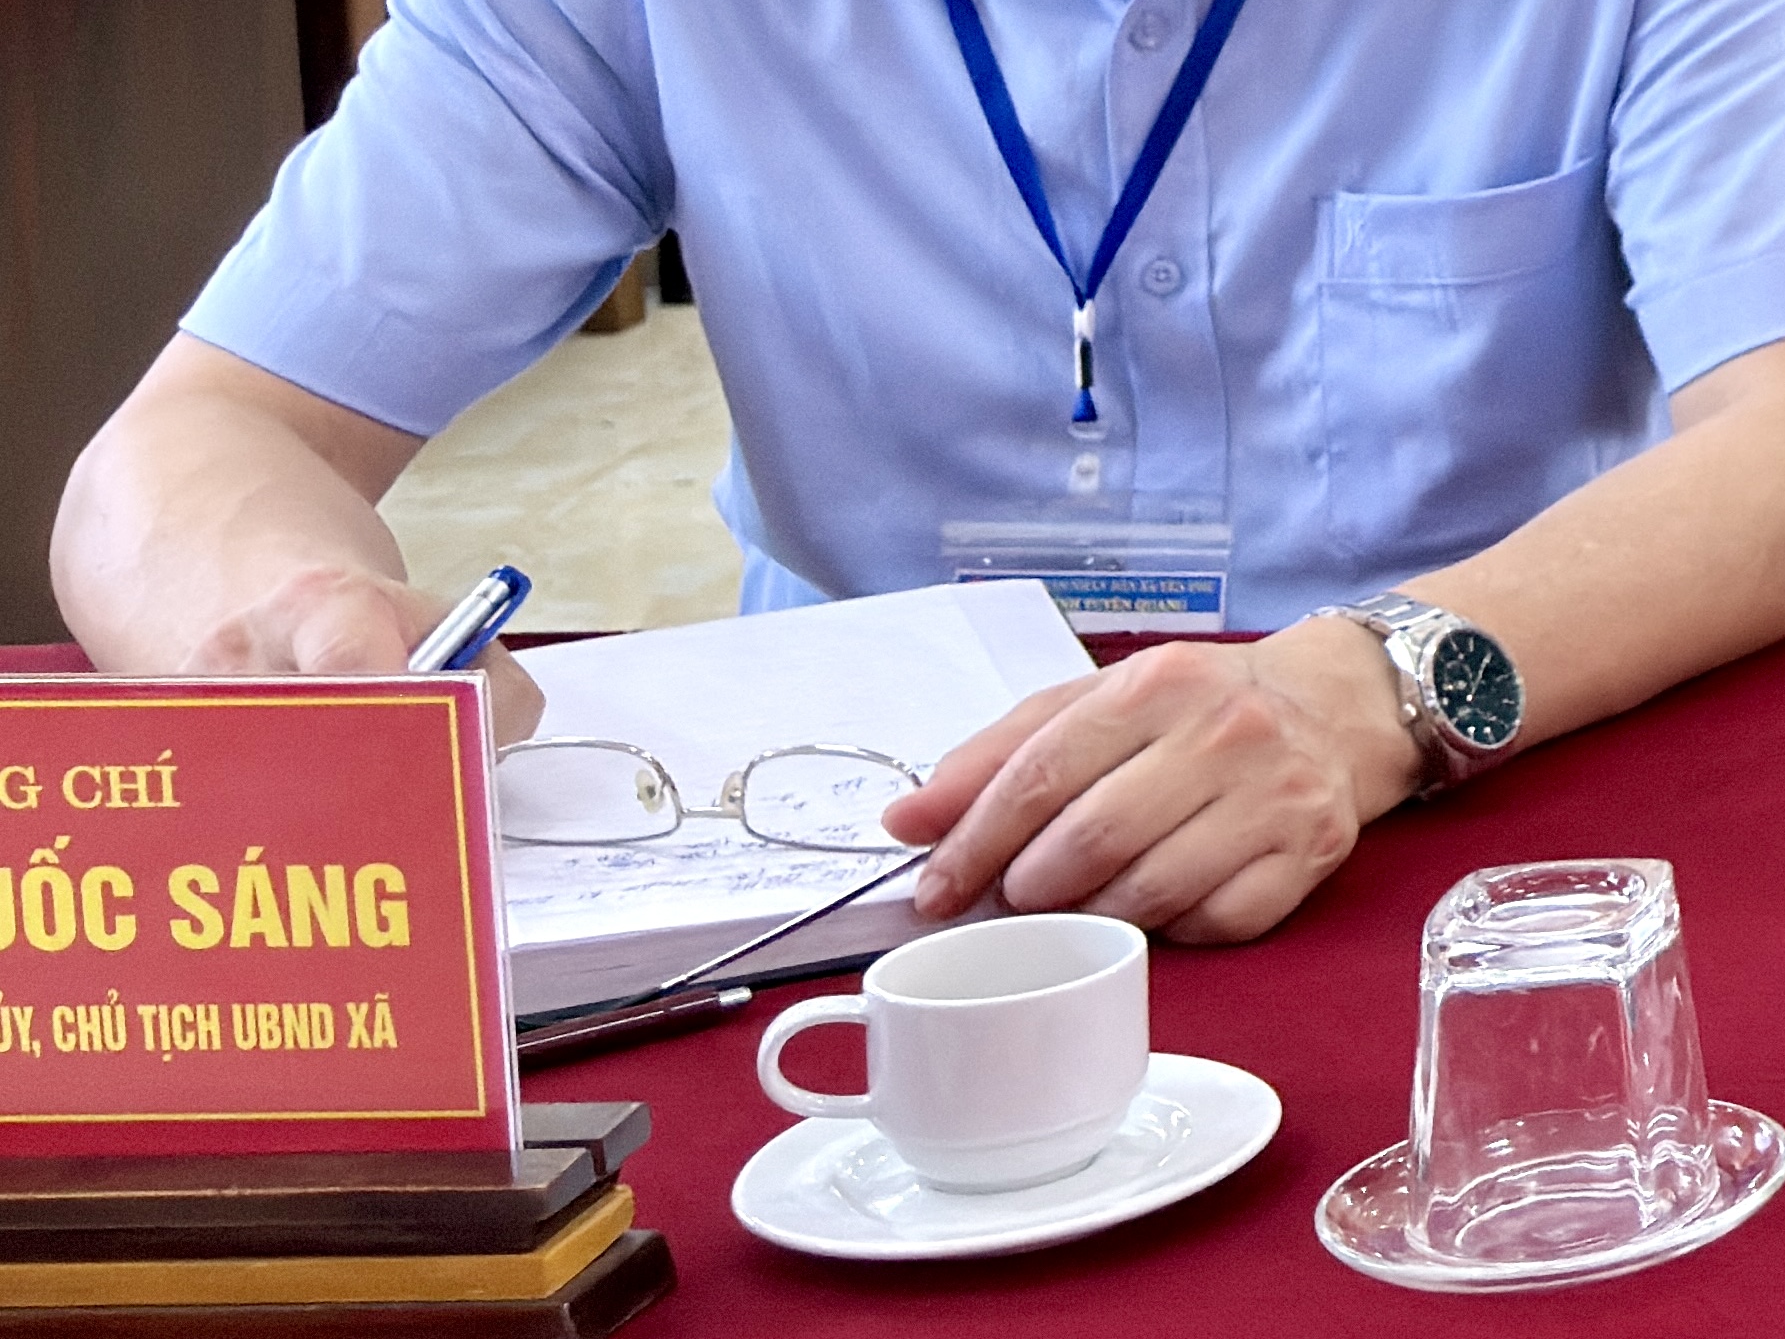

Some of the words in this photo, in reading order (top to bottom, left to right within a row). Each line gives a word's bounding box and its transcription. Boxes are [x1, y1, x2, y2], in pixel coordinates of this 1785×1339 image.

[63, 751, 178, 809] CHÍ
[168, 846, 410, 950] SÁNG
[52, 991, 127, 1052] CHỦ
[138, 1005, 222, 1062] TỊCH
[232, 1003, 335, 1050] UBND
[347, 994, 397, 1049] XÃ
